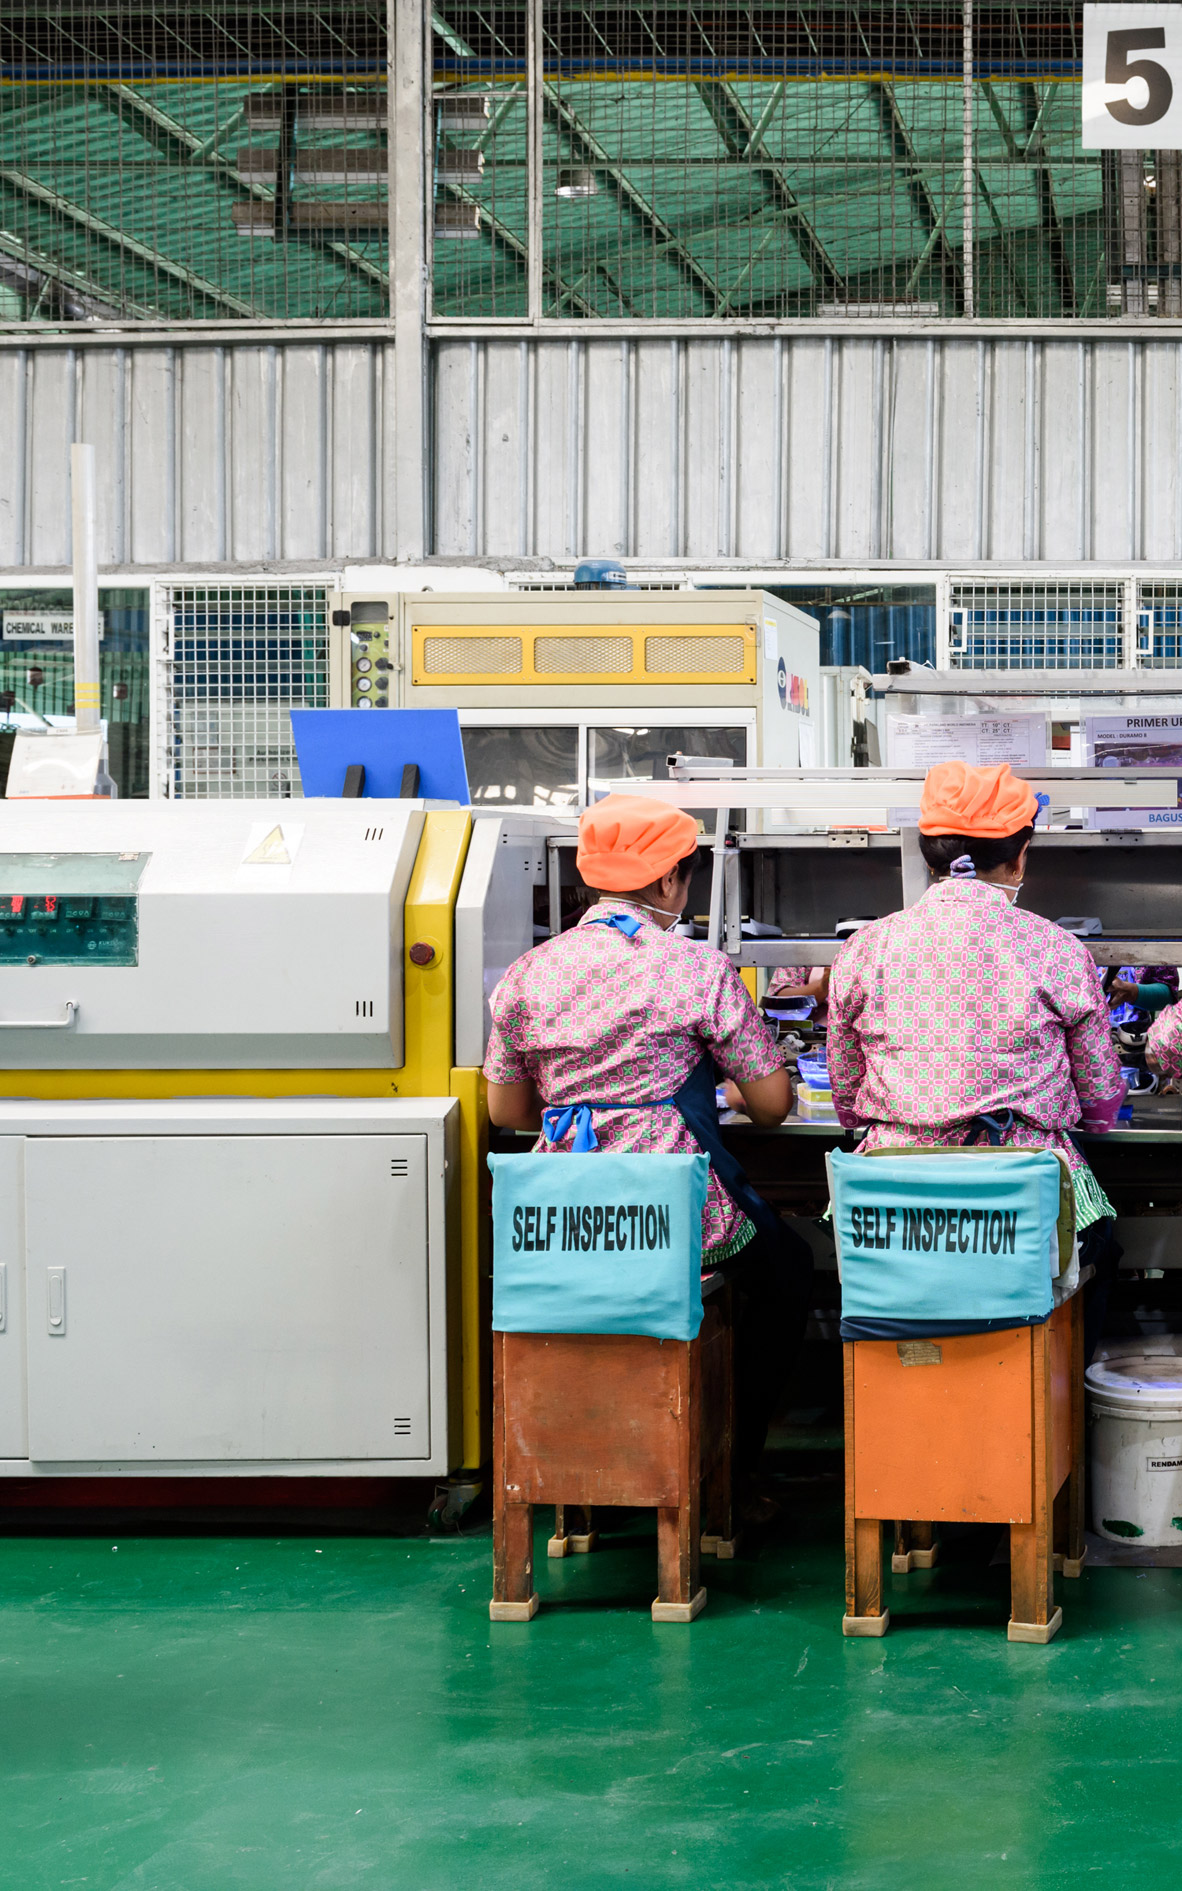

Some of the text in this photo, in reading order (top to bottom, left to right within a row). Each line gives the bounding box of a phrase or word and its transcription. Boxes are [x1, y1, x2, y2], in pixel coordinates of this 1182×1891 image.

[1104, 26, 1173, 126] 5
[6, 622, 46, 634] CHEMICAL
[1126, 717, 1169, 728] PRIMER
[512, 1204, 670, 1252] SELF INSPECTION
[851, 1207, 1017, 1255] SELF INSPECTION
